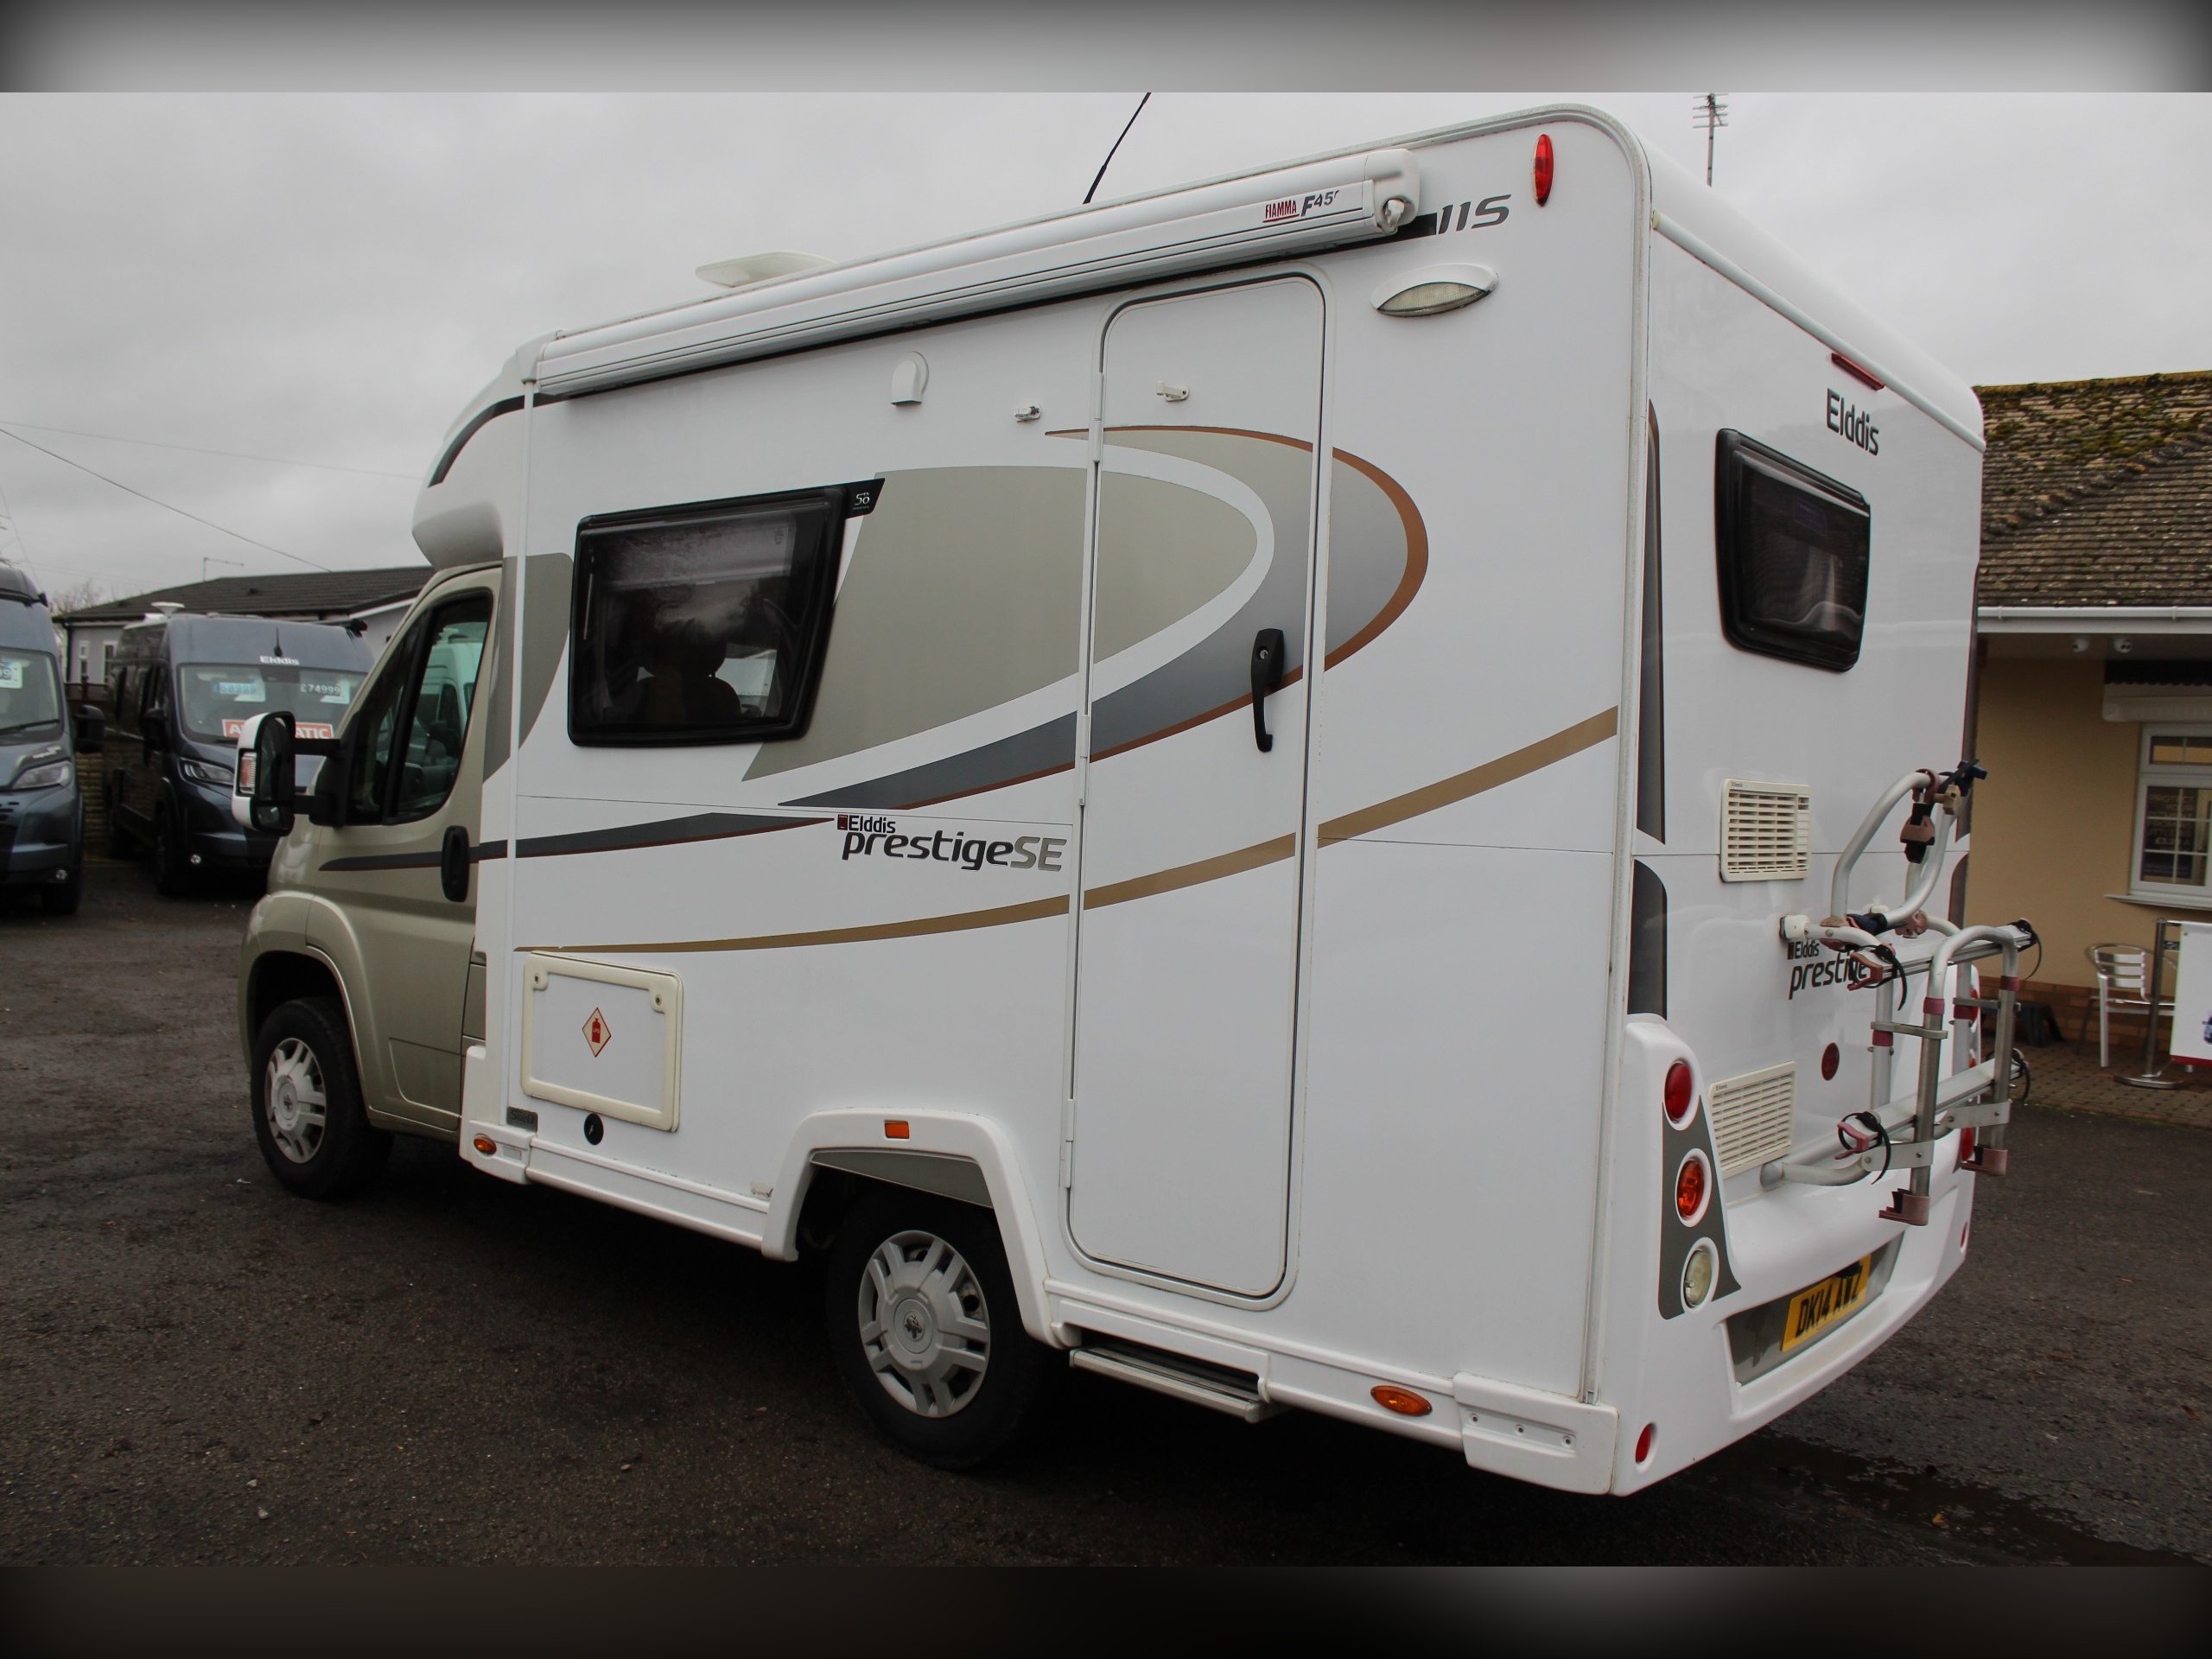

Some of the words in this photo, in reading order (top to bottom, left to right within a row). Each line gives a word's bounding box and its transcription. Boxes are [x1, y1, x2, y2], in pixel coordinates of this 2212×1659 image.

[1265, 200, 1297, 219] FIAMMA
[1826, 387, 1879, 456] Elddis
[849, 815, 896, 834] Elddis
[842, 830, 1067, 872] prestigeSE
[1795, 939, 1820, 959] Elddis
